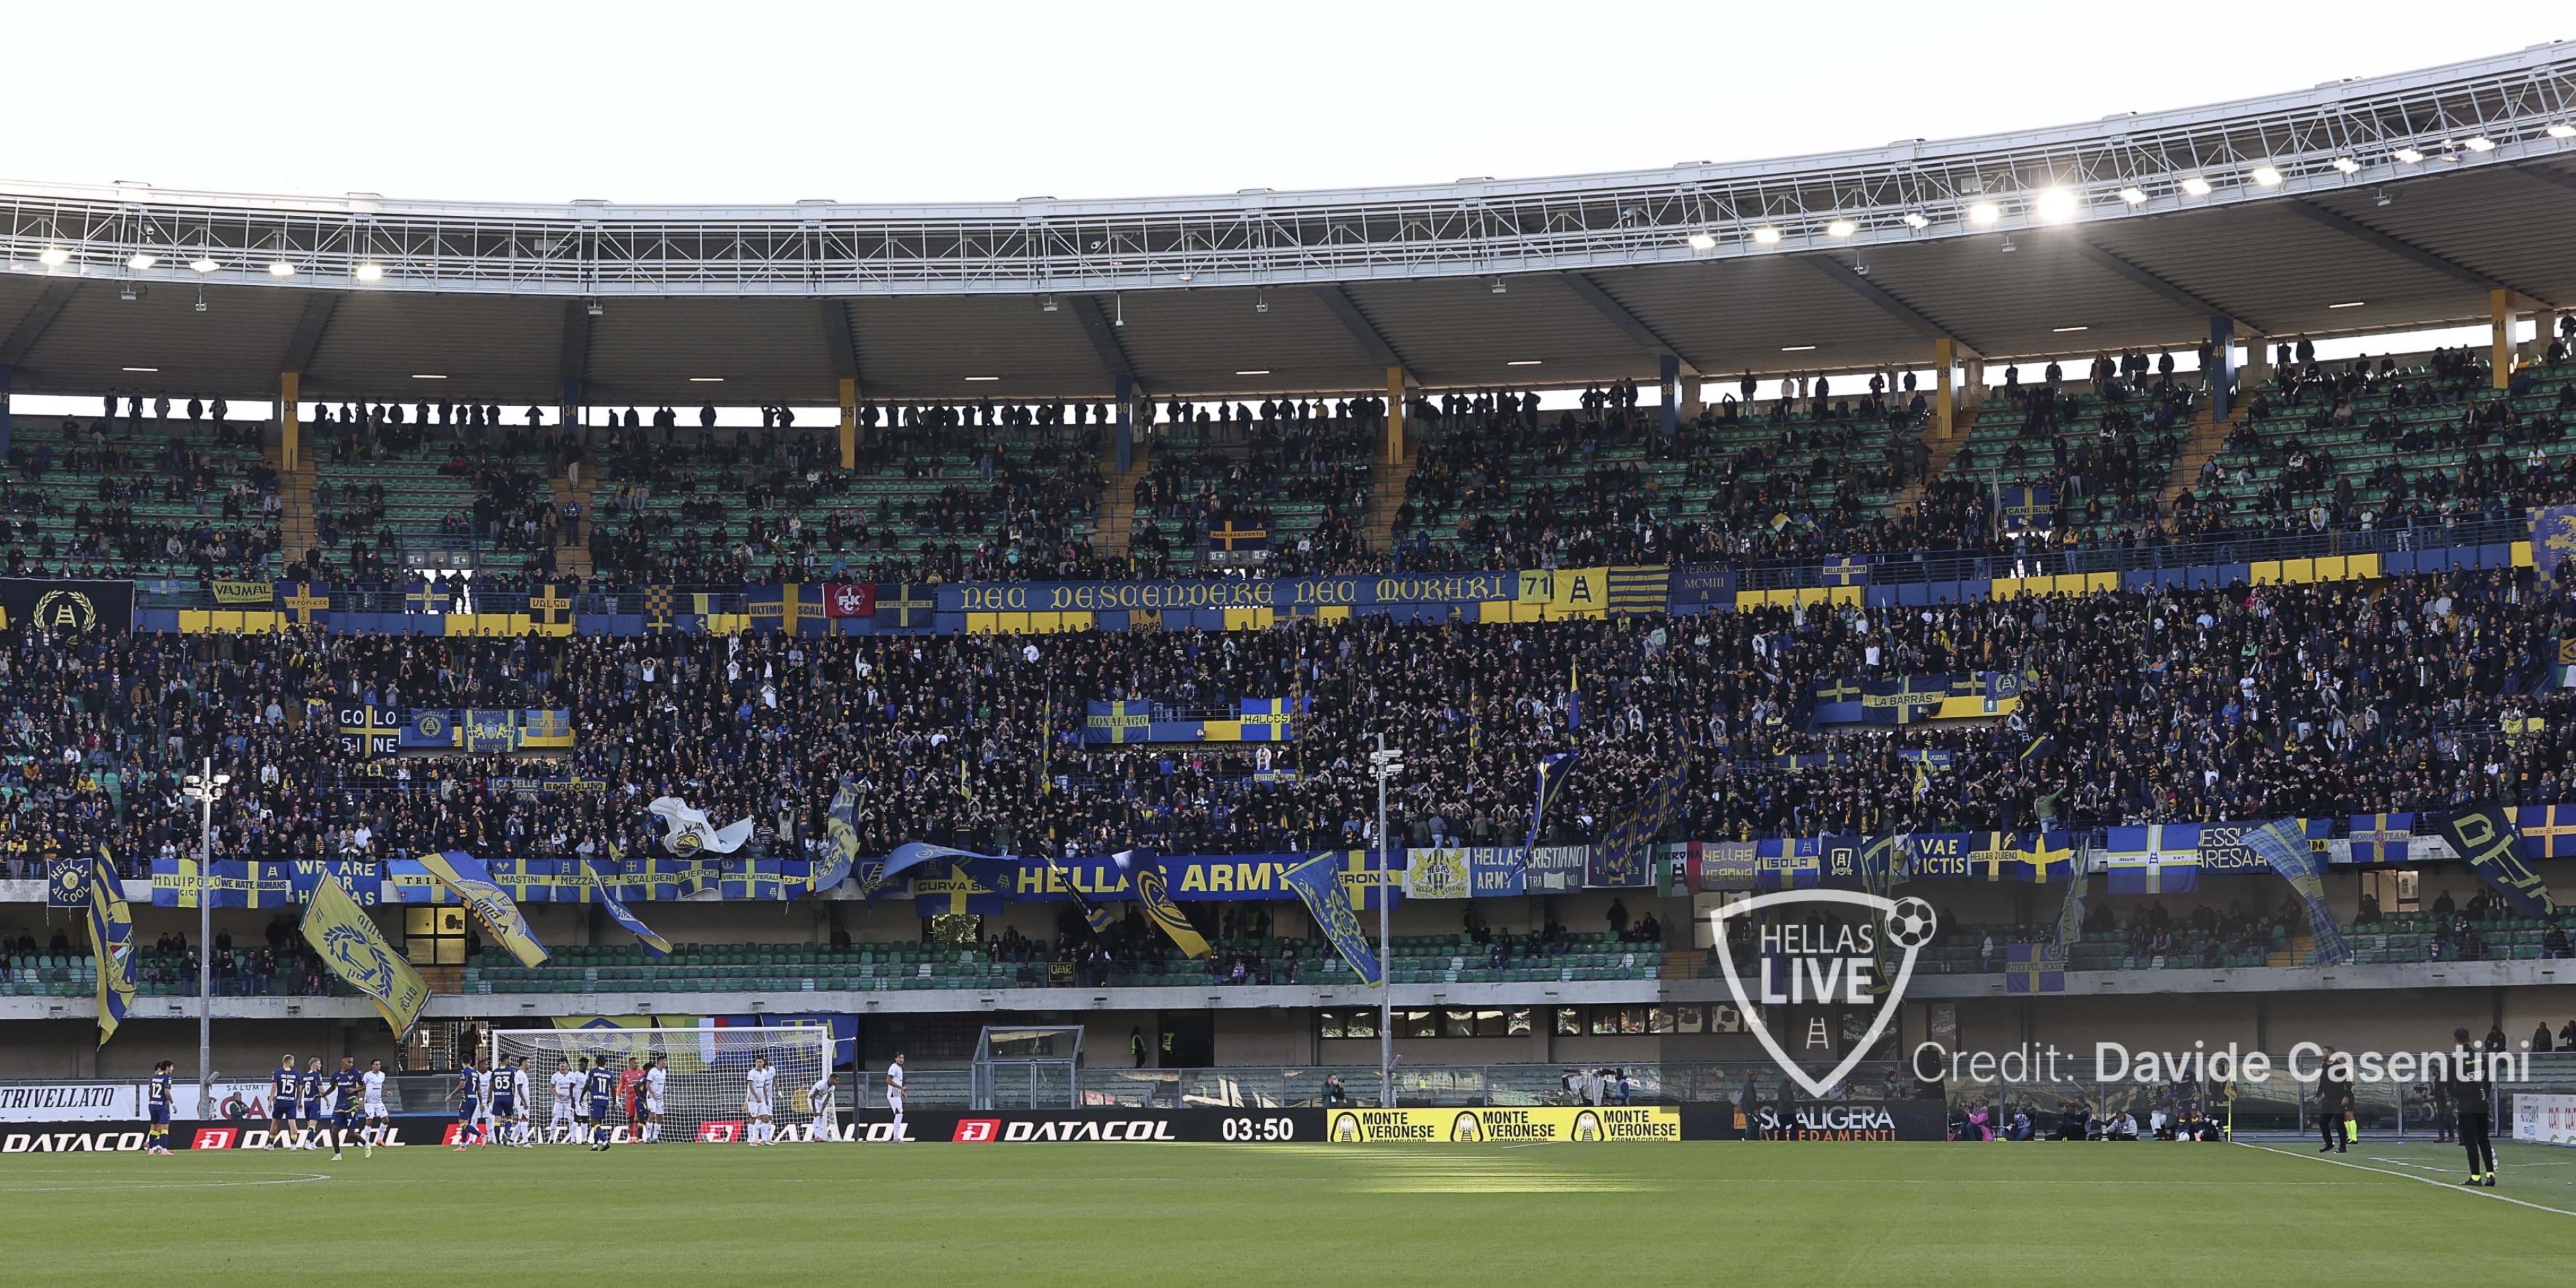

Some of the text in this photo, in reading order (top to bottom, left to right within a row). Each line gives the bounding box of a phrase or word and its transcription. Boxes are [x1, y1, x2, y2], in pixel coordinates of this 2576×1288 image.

[2212, 346, 2224, 358] 40
[1938, 368, 1949, 378] 39
[1662, 384, 1673, 395] 38
[285, 400, 296, 411] 33
[1390, 396, 1399, 406] 37
[566, 405, 576, 415] 34
[842, 407, 853, 417] 35
[1118, 402, 1128, 413] 36
[1681, 564, 1729, 574] VERONA
[1684, 578, 1724, 588] MCMIII
[751, 604, 783, 614] ULTIMO
[1090, 716, 1146, 727] ZONALAGO
[1921, 839, 1958, 855] VAE
[1474, 848, 1522, 865] HELLAS
[1527, 847, 1583, 868] CRISTIANO
[1658, 849, 1702, 861] VERONA
[1702, 849, 1753, 862] HELLAS
[1970, 851, 1992, 860] HELLAS
[50, 860, 89, 879] HELLAS
[338, 863, 375, 876] ARE
[1767, 859, 1808, 868] ISOLA
[679, 870, 718, 882] QUEPOS
[1428, 865, 1449, 875] HELLAS
[502, 875, 541, 883] MASTINI
[627, 875, 675, 884] SCALIGERI
[1181, 863, 1299, 892] ARMY
[1477, 871, 1511, 890] ARMY
[1529, 876, 1542, 886] TRA
[1567, 874, 1578, 885] NOI
[221, 879, 286, 890] WE HATE HUMANS
[919, 881, 967, 892] CURVA
[52, 885, 90, 902] ALCOOL
[281, 1079, 295, 1094] 15
[305, 1081, 311, 1095] 6
[472, 1077, 477, 1092] 5
[494, 1075, 511, 1089] 63
[598, 1077, 607, 1093] 11
[152, 1083, 162, 1098] 12
[1, 1087, 115, 1109] TRIVELLATO
[1362, 1112, 1408, 1126] MONTE
[1483, 1111, 1528, 1124] MONTE
[1604, 1110, 1650, 1124] MONTE
[1004, 1121, 1175, 1141] DATACOL
[1222, 1117, 1293, 1140] 03:50
[1368, 1125, 1434, 1139] VERONESE
[1488, 1124, 1555, 1138] VERONESE
[1609, 1124, 1676, 1136] VERONESE
[1, 1132, 144, 1152] DATACO
